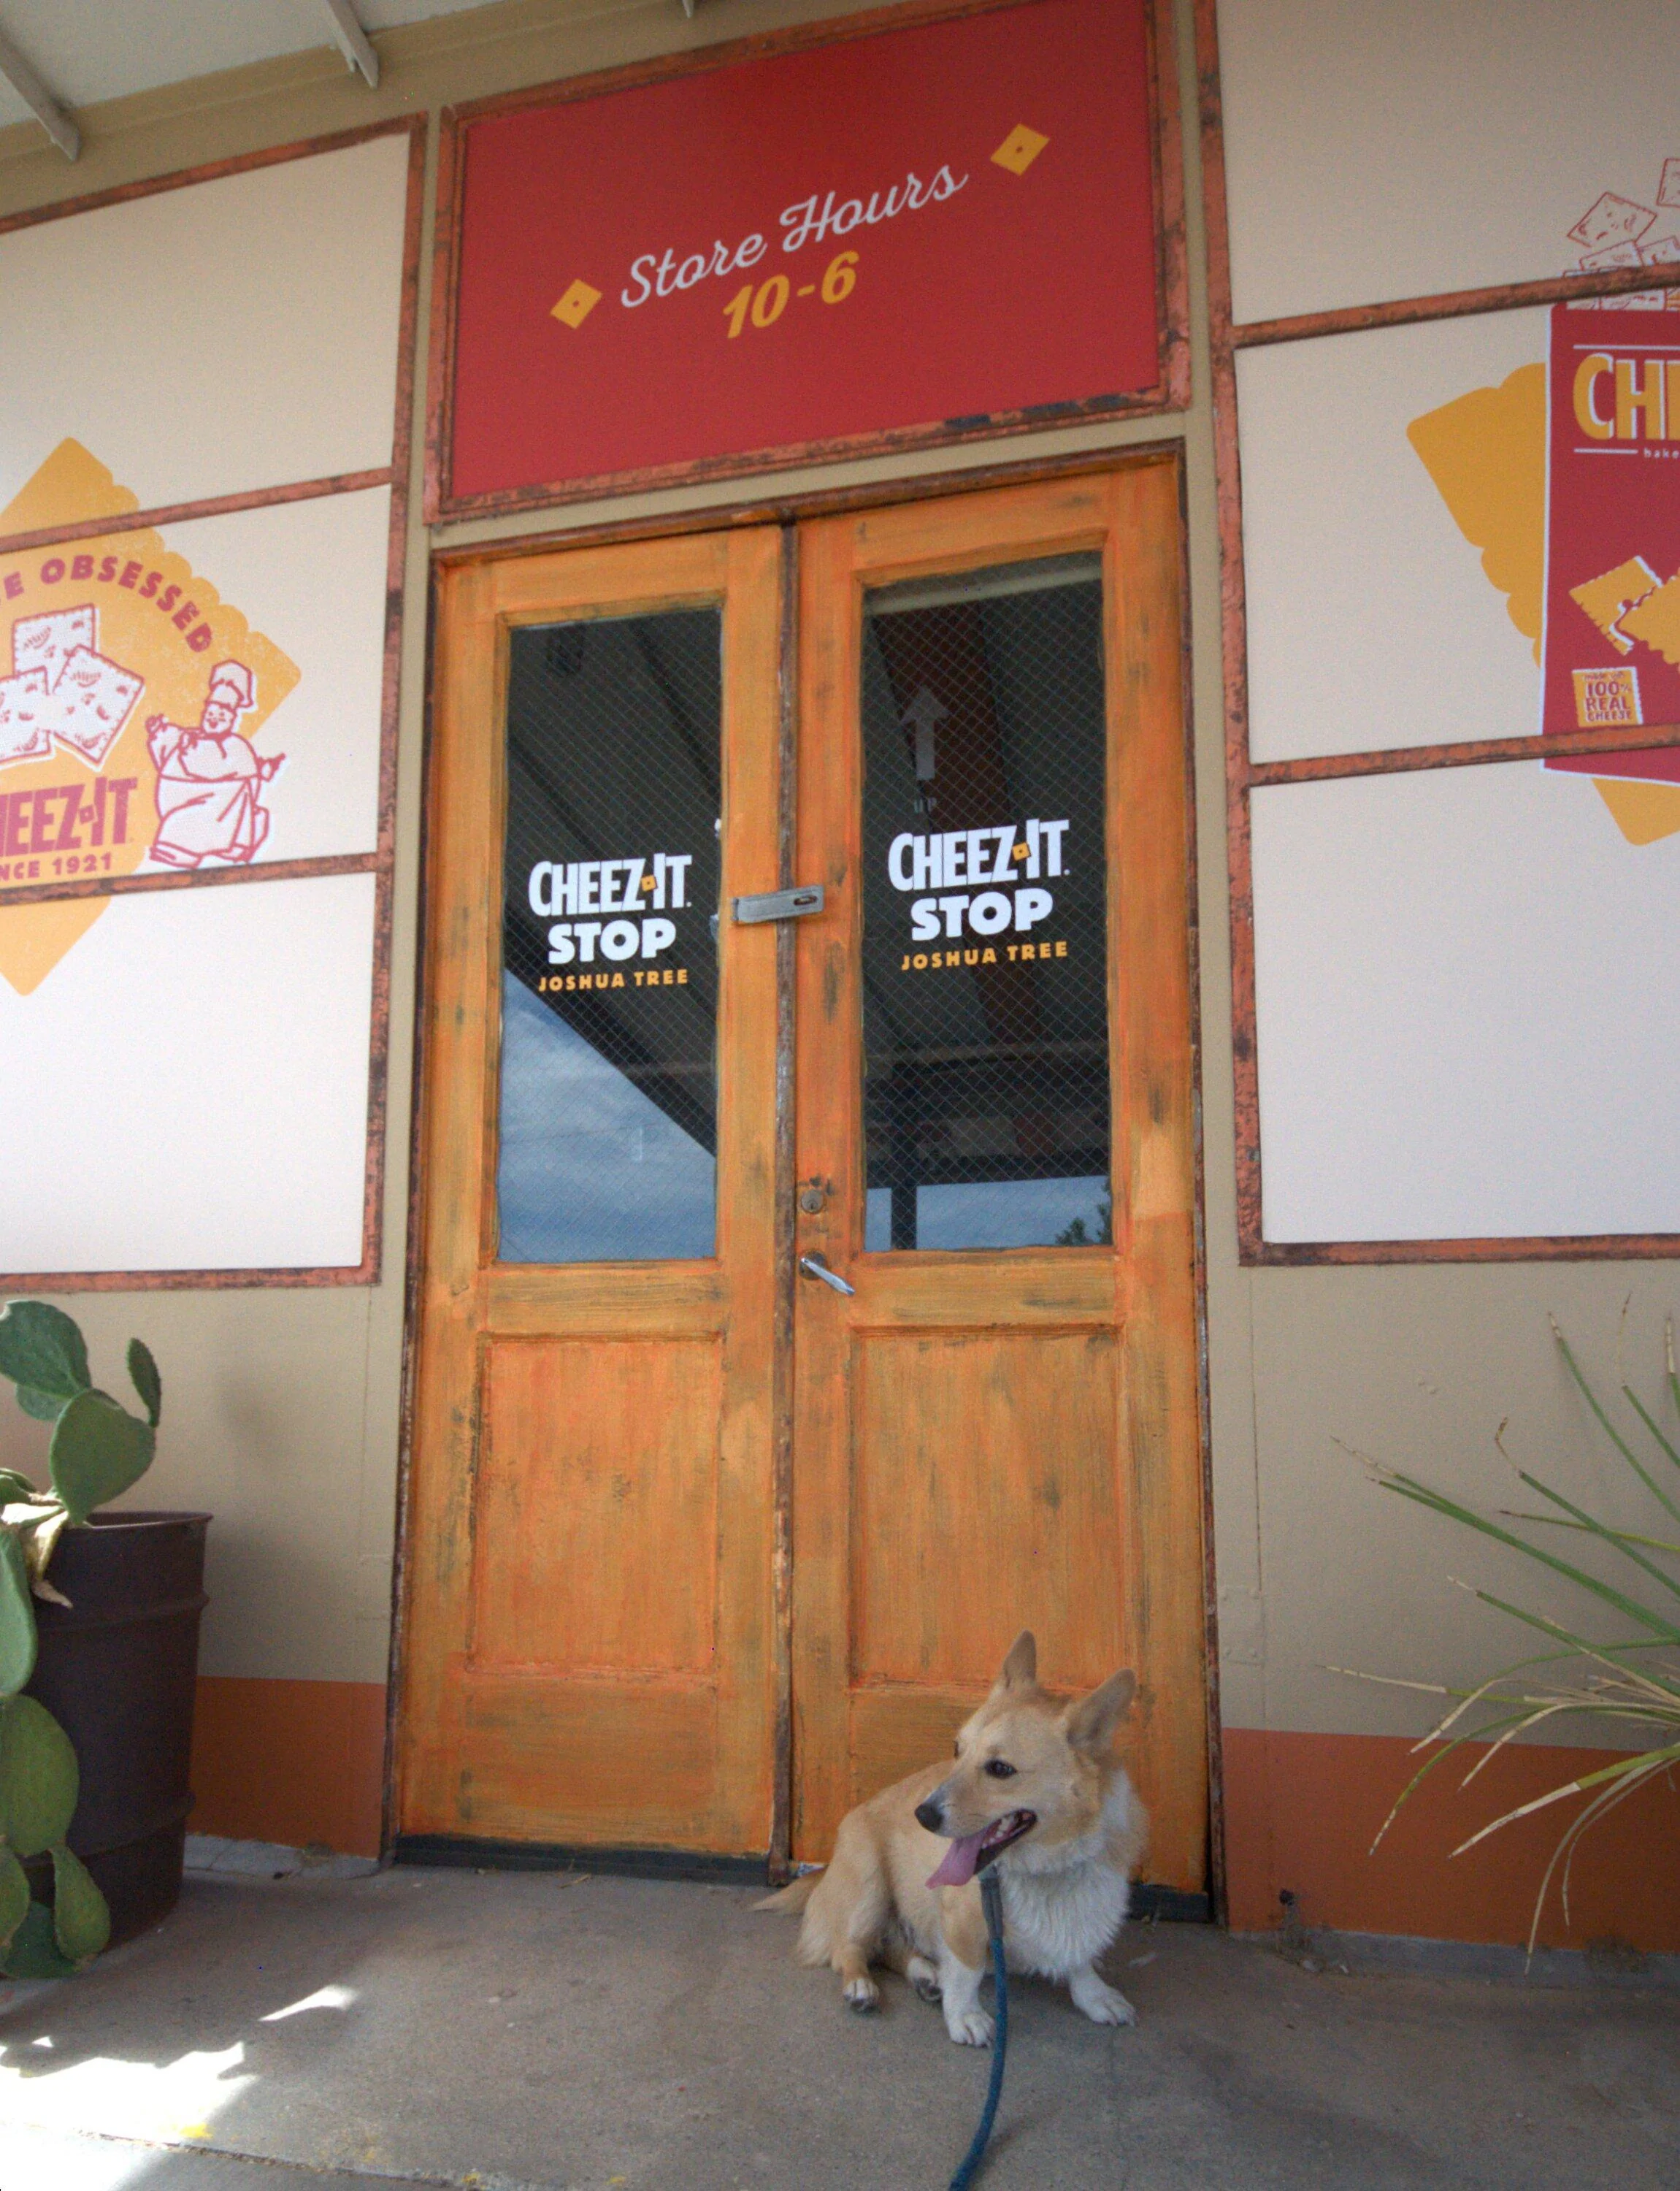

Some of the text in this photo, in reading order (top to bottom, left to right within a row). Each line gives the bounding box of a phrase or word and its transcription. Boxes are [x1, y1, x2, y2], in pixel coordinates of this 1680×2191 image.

[621, 164, 970, 309] Store Hours
[723, 251, 860, 340] 10-6
[40, 555, 213, 653] OBSESSED
[1585, 696, 1631, 712] REAL
[52, 852, 112, 876] 1921
[910, 887, 1054, 941] STOP
[548, 918, 676, 965] STOP
[901, 941, 1067, 971] JOSHUA TREE
[538, 968, 688, 992] JOSHUA TREE
